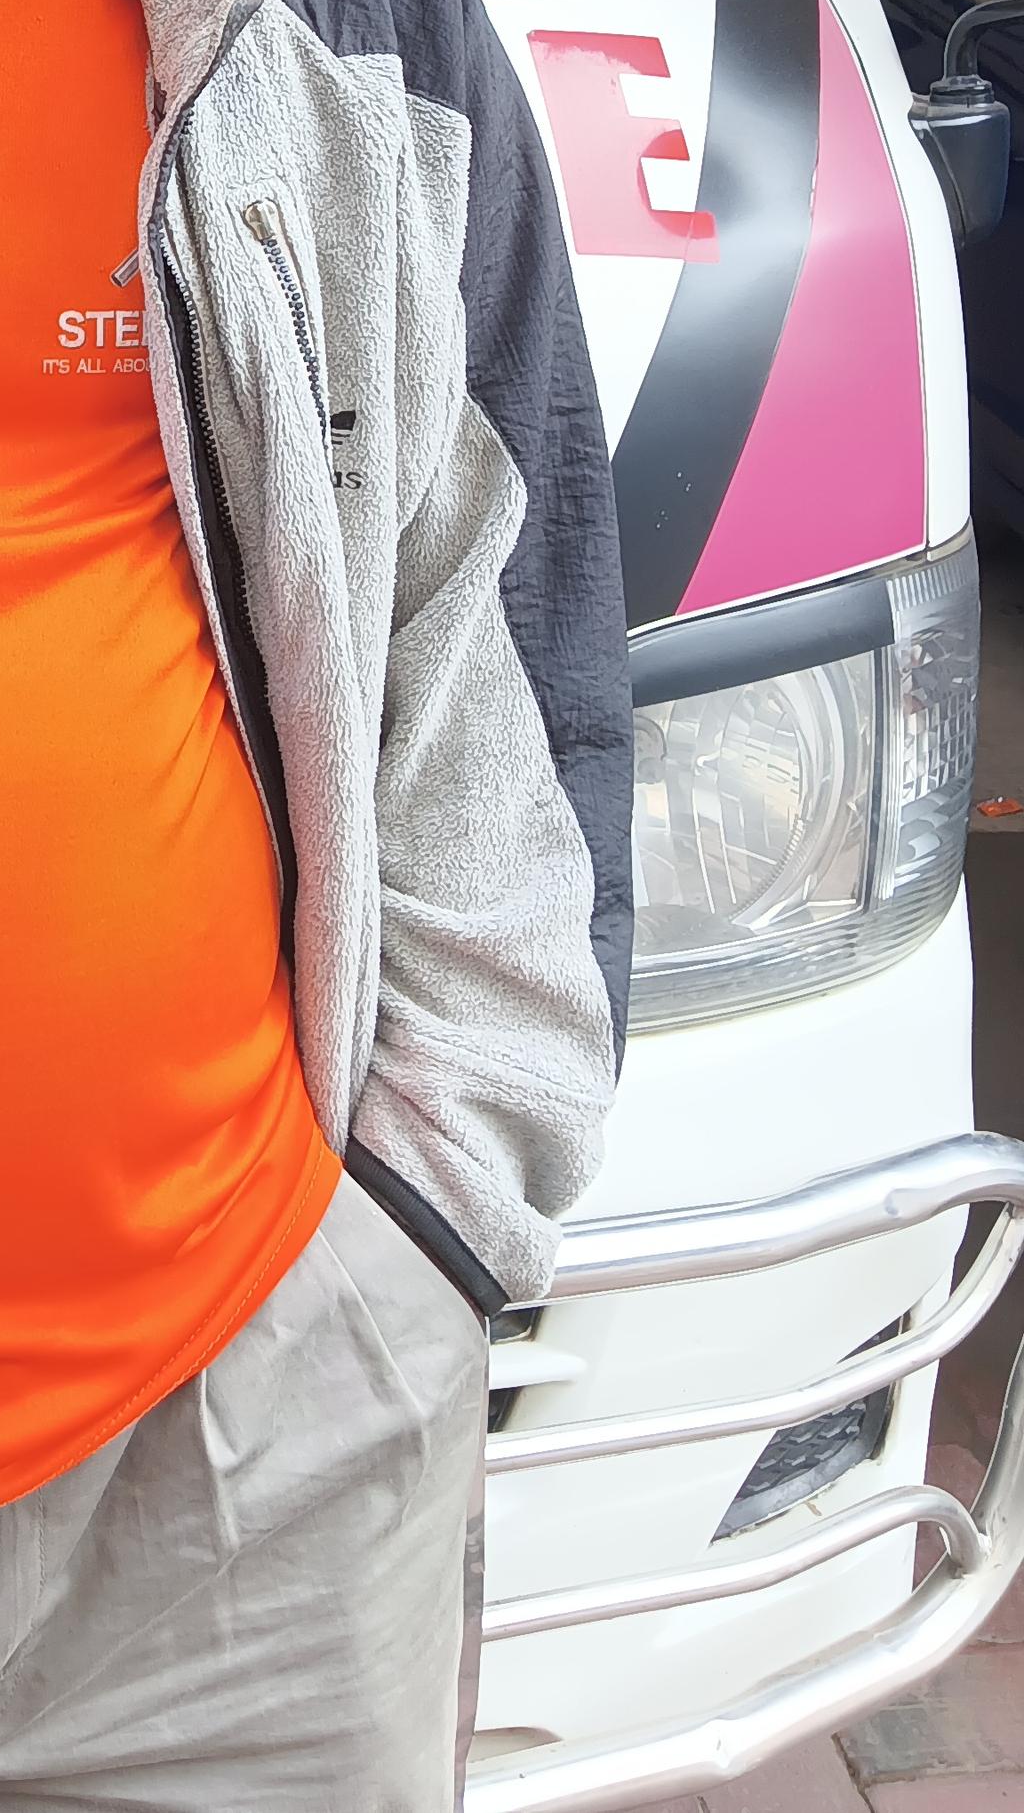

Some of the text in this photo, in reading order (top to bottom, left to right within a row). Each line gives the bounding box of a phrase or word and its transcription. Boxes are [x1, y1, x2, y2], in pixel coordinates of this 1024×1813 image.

[58, 310, 150, 348] STE
[42, 359, 70, 374] IT'S
[76, 358, 106, 374] ALL
